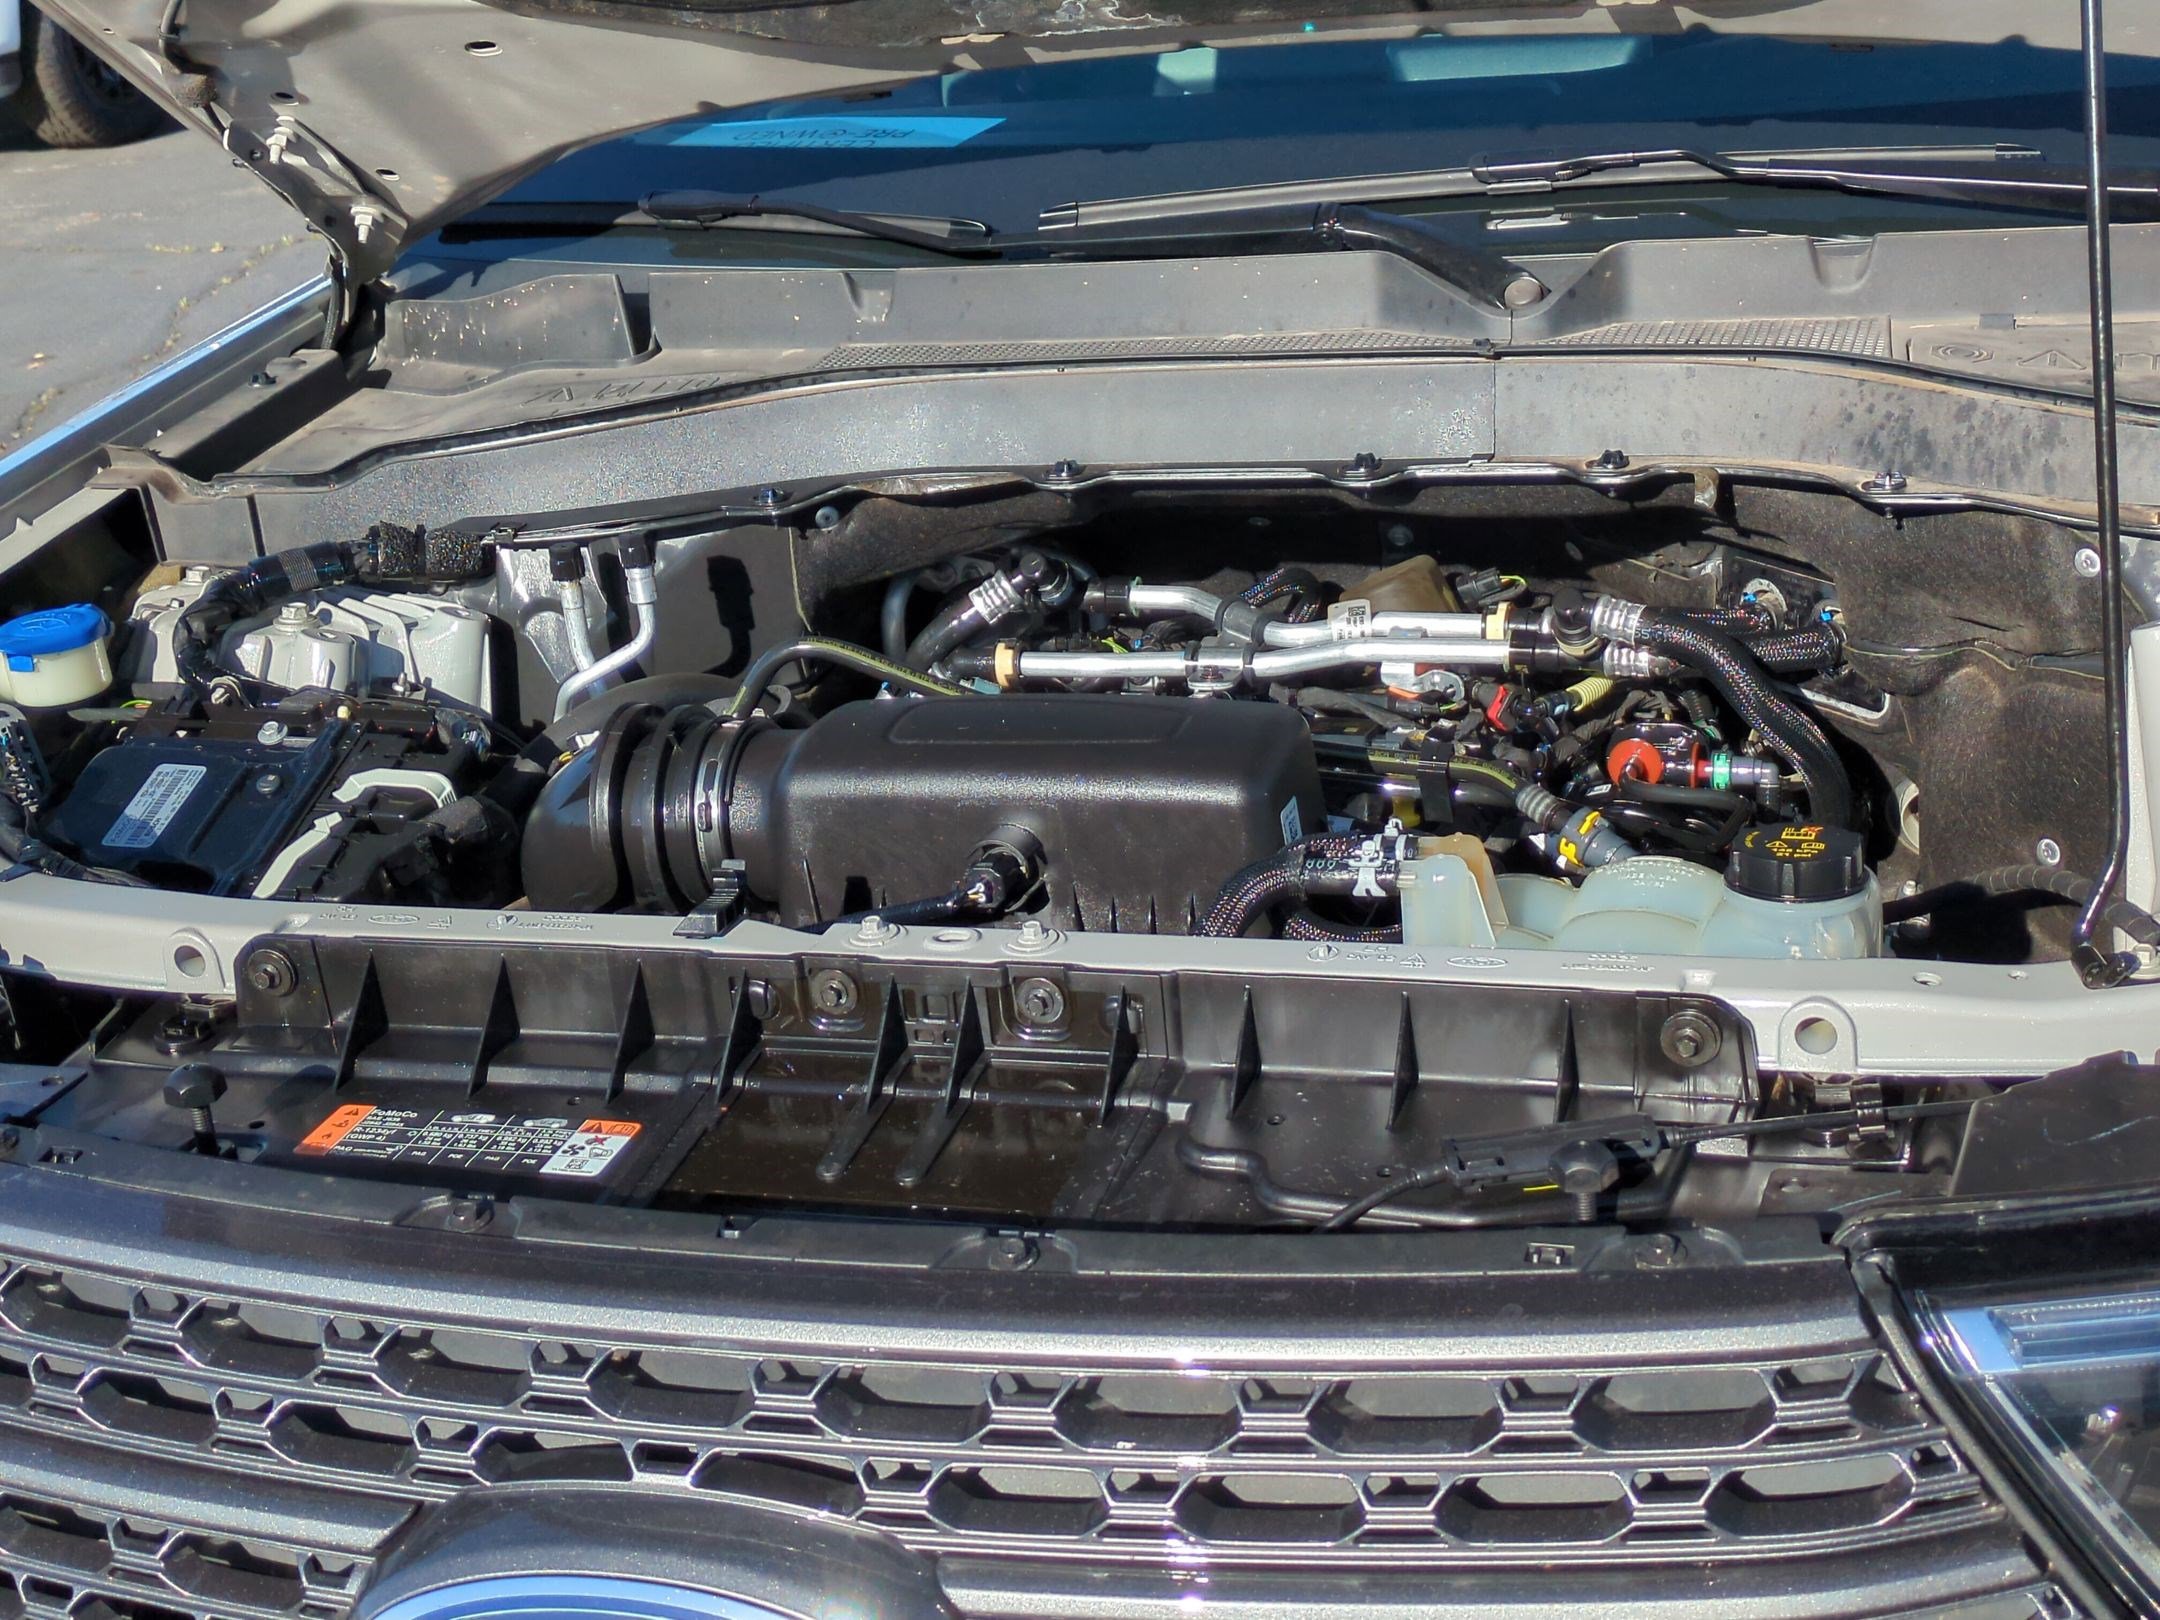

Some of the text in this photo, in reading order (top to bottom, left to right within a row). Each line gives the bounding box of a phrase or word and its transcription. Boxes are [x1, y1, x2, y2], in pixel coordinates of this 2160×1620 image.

[371, 1108, 418, 1119] FoMoCo
[353, 1126, 398, 1136] R-1234yf
[345, 1133, 376, 1141] (GWP
